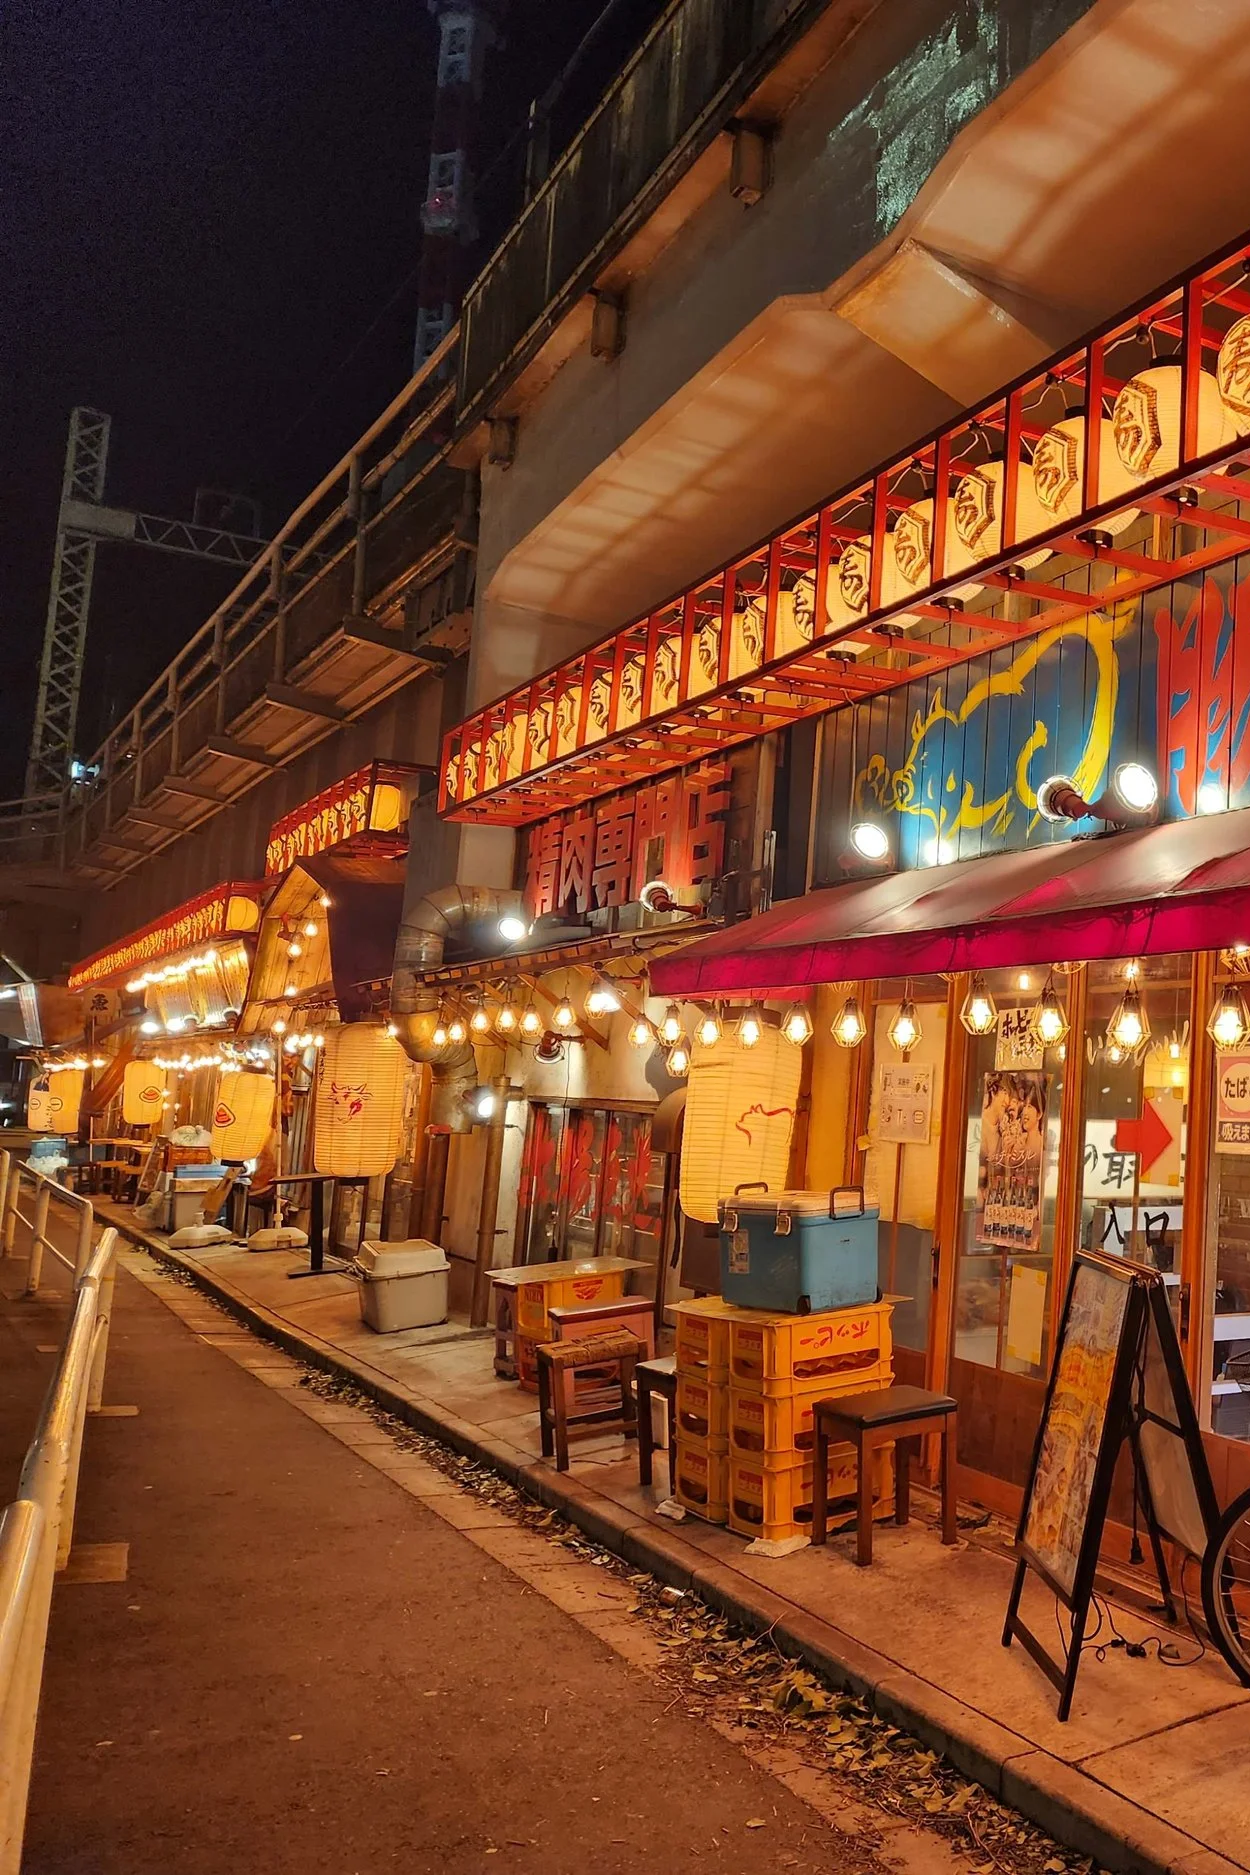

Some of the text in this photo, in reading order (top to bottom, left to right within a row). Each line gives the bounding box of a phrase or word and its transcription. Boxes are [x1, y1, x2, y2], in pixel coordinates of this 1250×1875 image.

[1100, 1199, 1170, 1247] 入口
[799, 1319, 871, 1351] ホッピー
